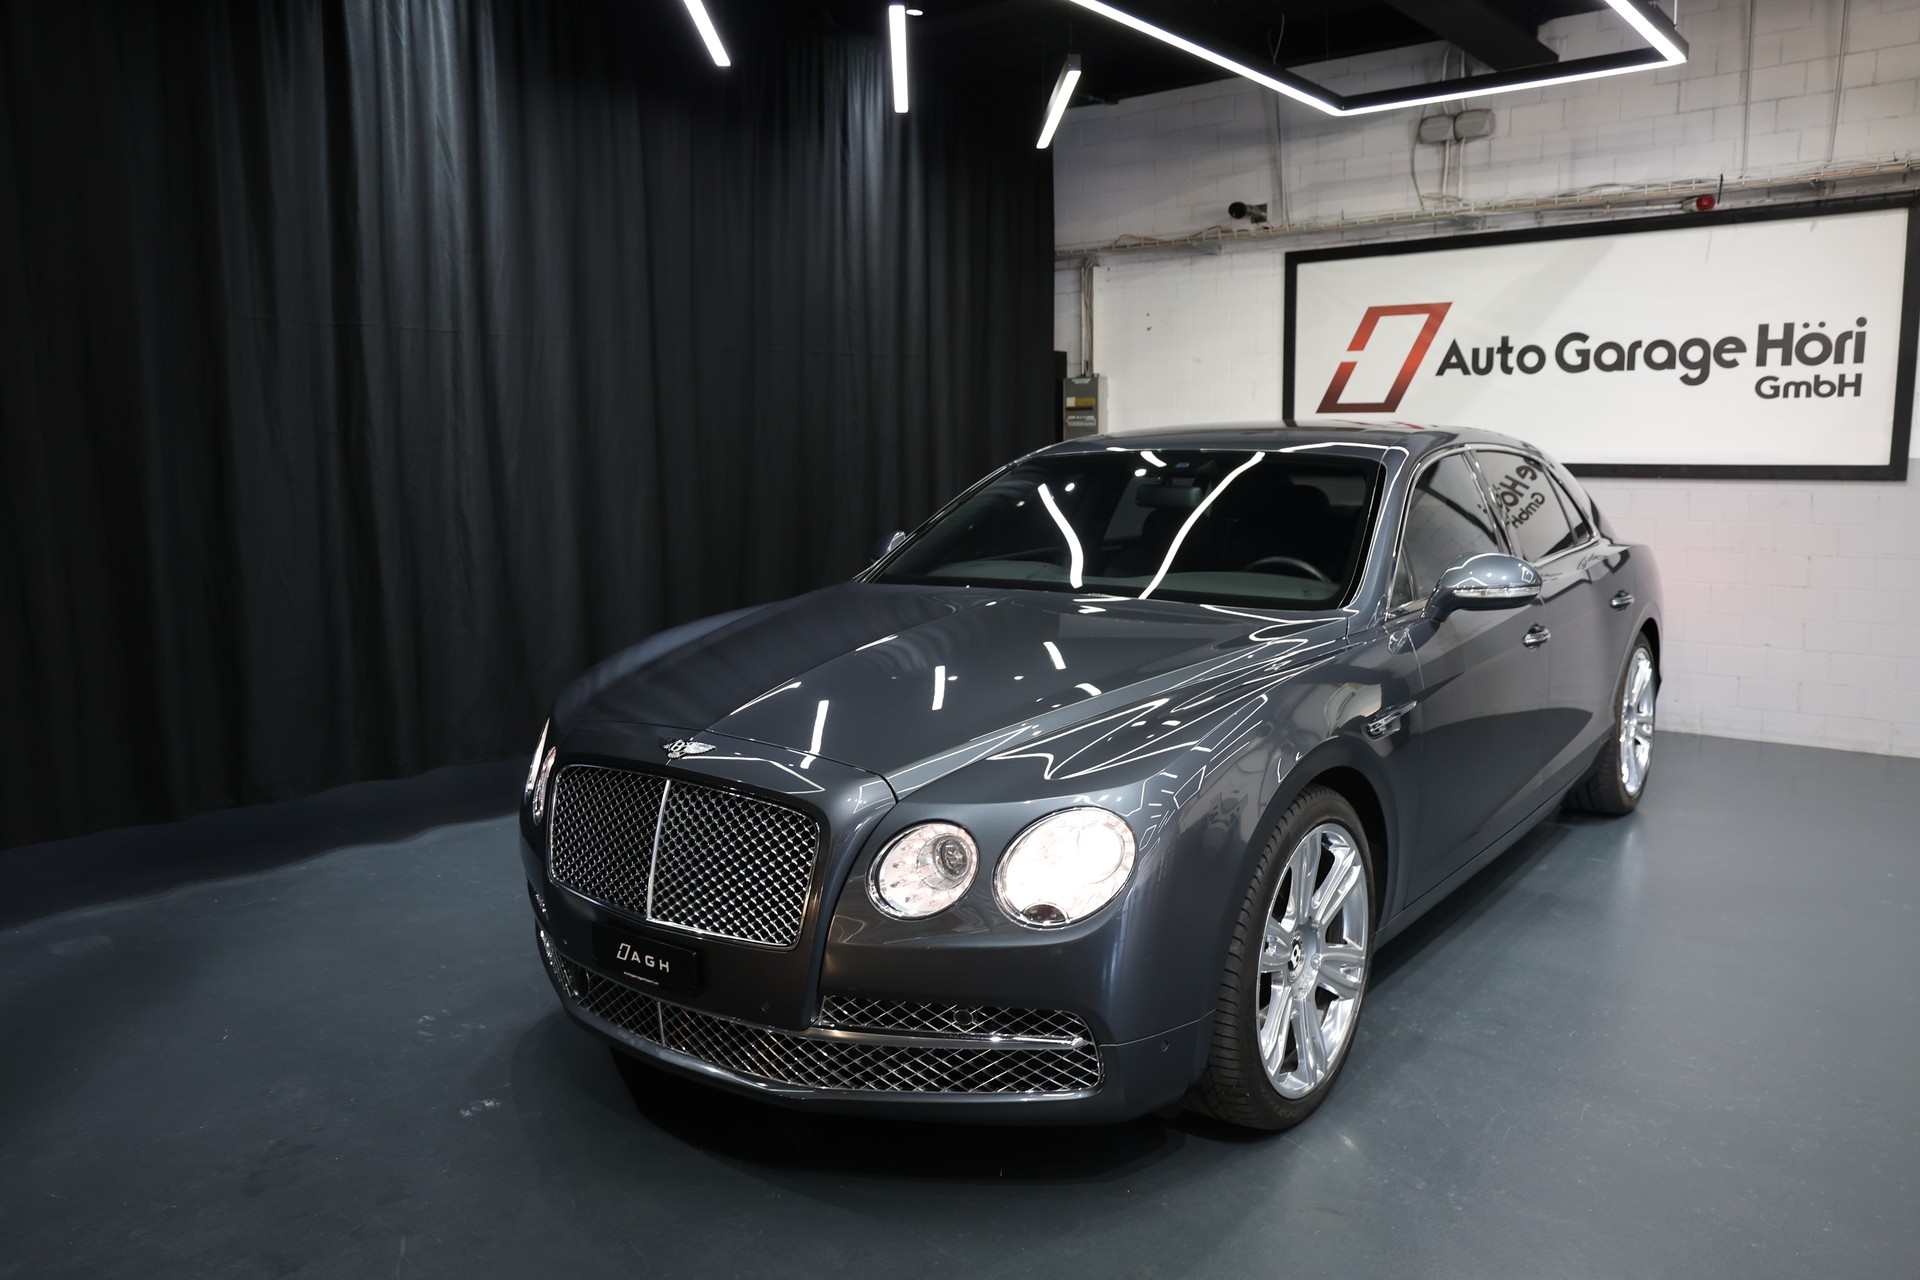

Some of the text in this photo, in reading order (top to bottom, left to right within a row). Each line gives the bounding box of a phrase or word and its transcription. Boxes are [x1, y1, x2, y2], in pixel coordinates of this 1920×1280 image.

[1435, 316, 1868, 387] Auto Garage Höri
[1754, 373, 1863, 400] GmbH
[631, 950, 670, 973] AGH
